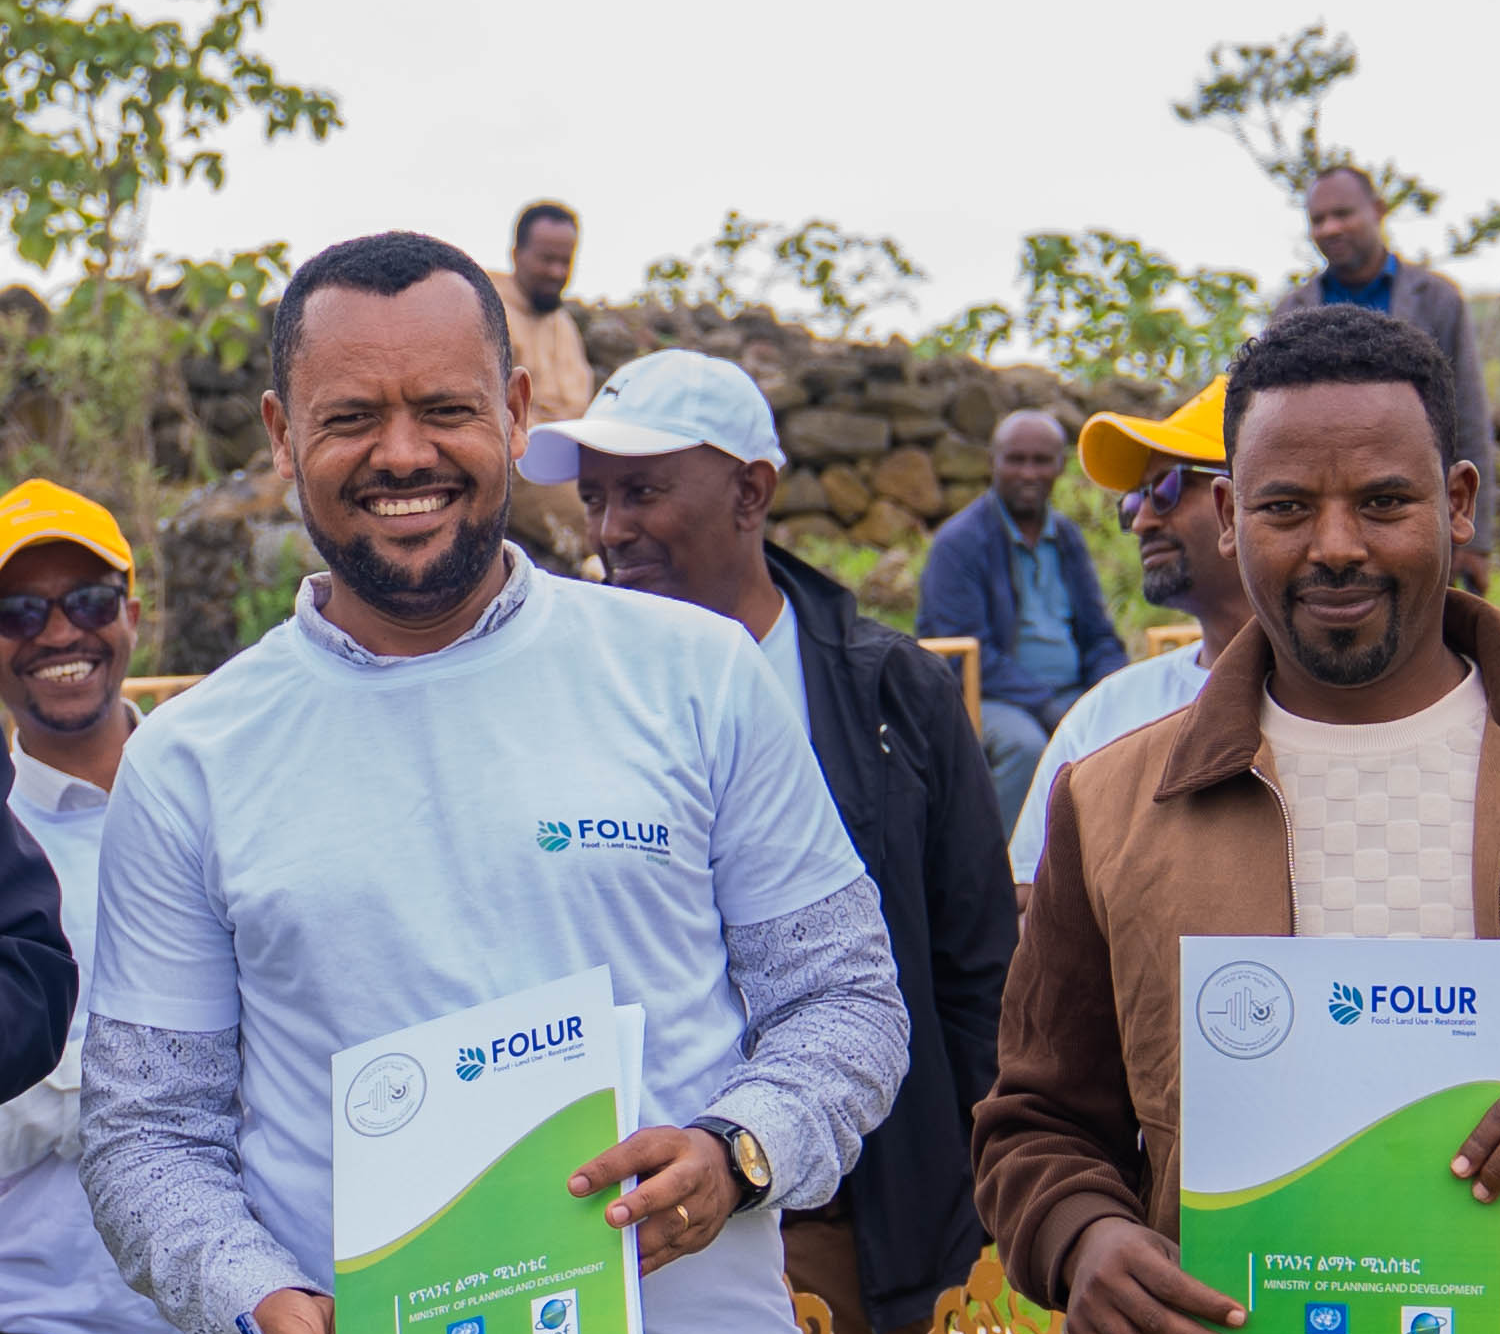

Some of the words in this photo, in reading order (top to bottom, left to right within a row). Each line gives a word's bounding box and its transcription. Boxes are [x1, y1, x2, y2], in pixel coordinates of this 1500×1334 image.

[578, 819, 669, 846] FOLUR
[1371, 985, 1477, 1014] FOLUR
[1371, 1016, 1390, 1025] Food
[1396, 1017, 1413, 1025] Land
[1415, 1017, 1428, 1025] Use
[492, 1016, 584, 1063] FOLUR
[455, 1272, 489, 1292] ልማት
[493, 1255, 547, 1280] ሚኒስቴር
[1317, 1256, 1356, 1272] ልማት
[1361, 1257, 1421, 1275] ሚኒስቴር
[409, 1304, 450, 1323] MINISTRY
[453, 1299, 466, 1310] OF
[537, 1261, 605, 1287] DEVELOPMENT
[1264, 1279, 1310, 1290] MINISTRY
[1314, 1281, 1329, 1291] OF
[1409, 1284, 1485, 1295] DEVELOPMENT
